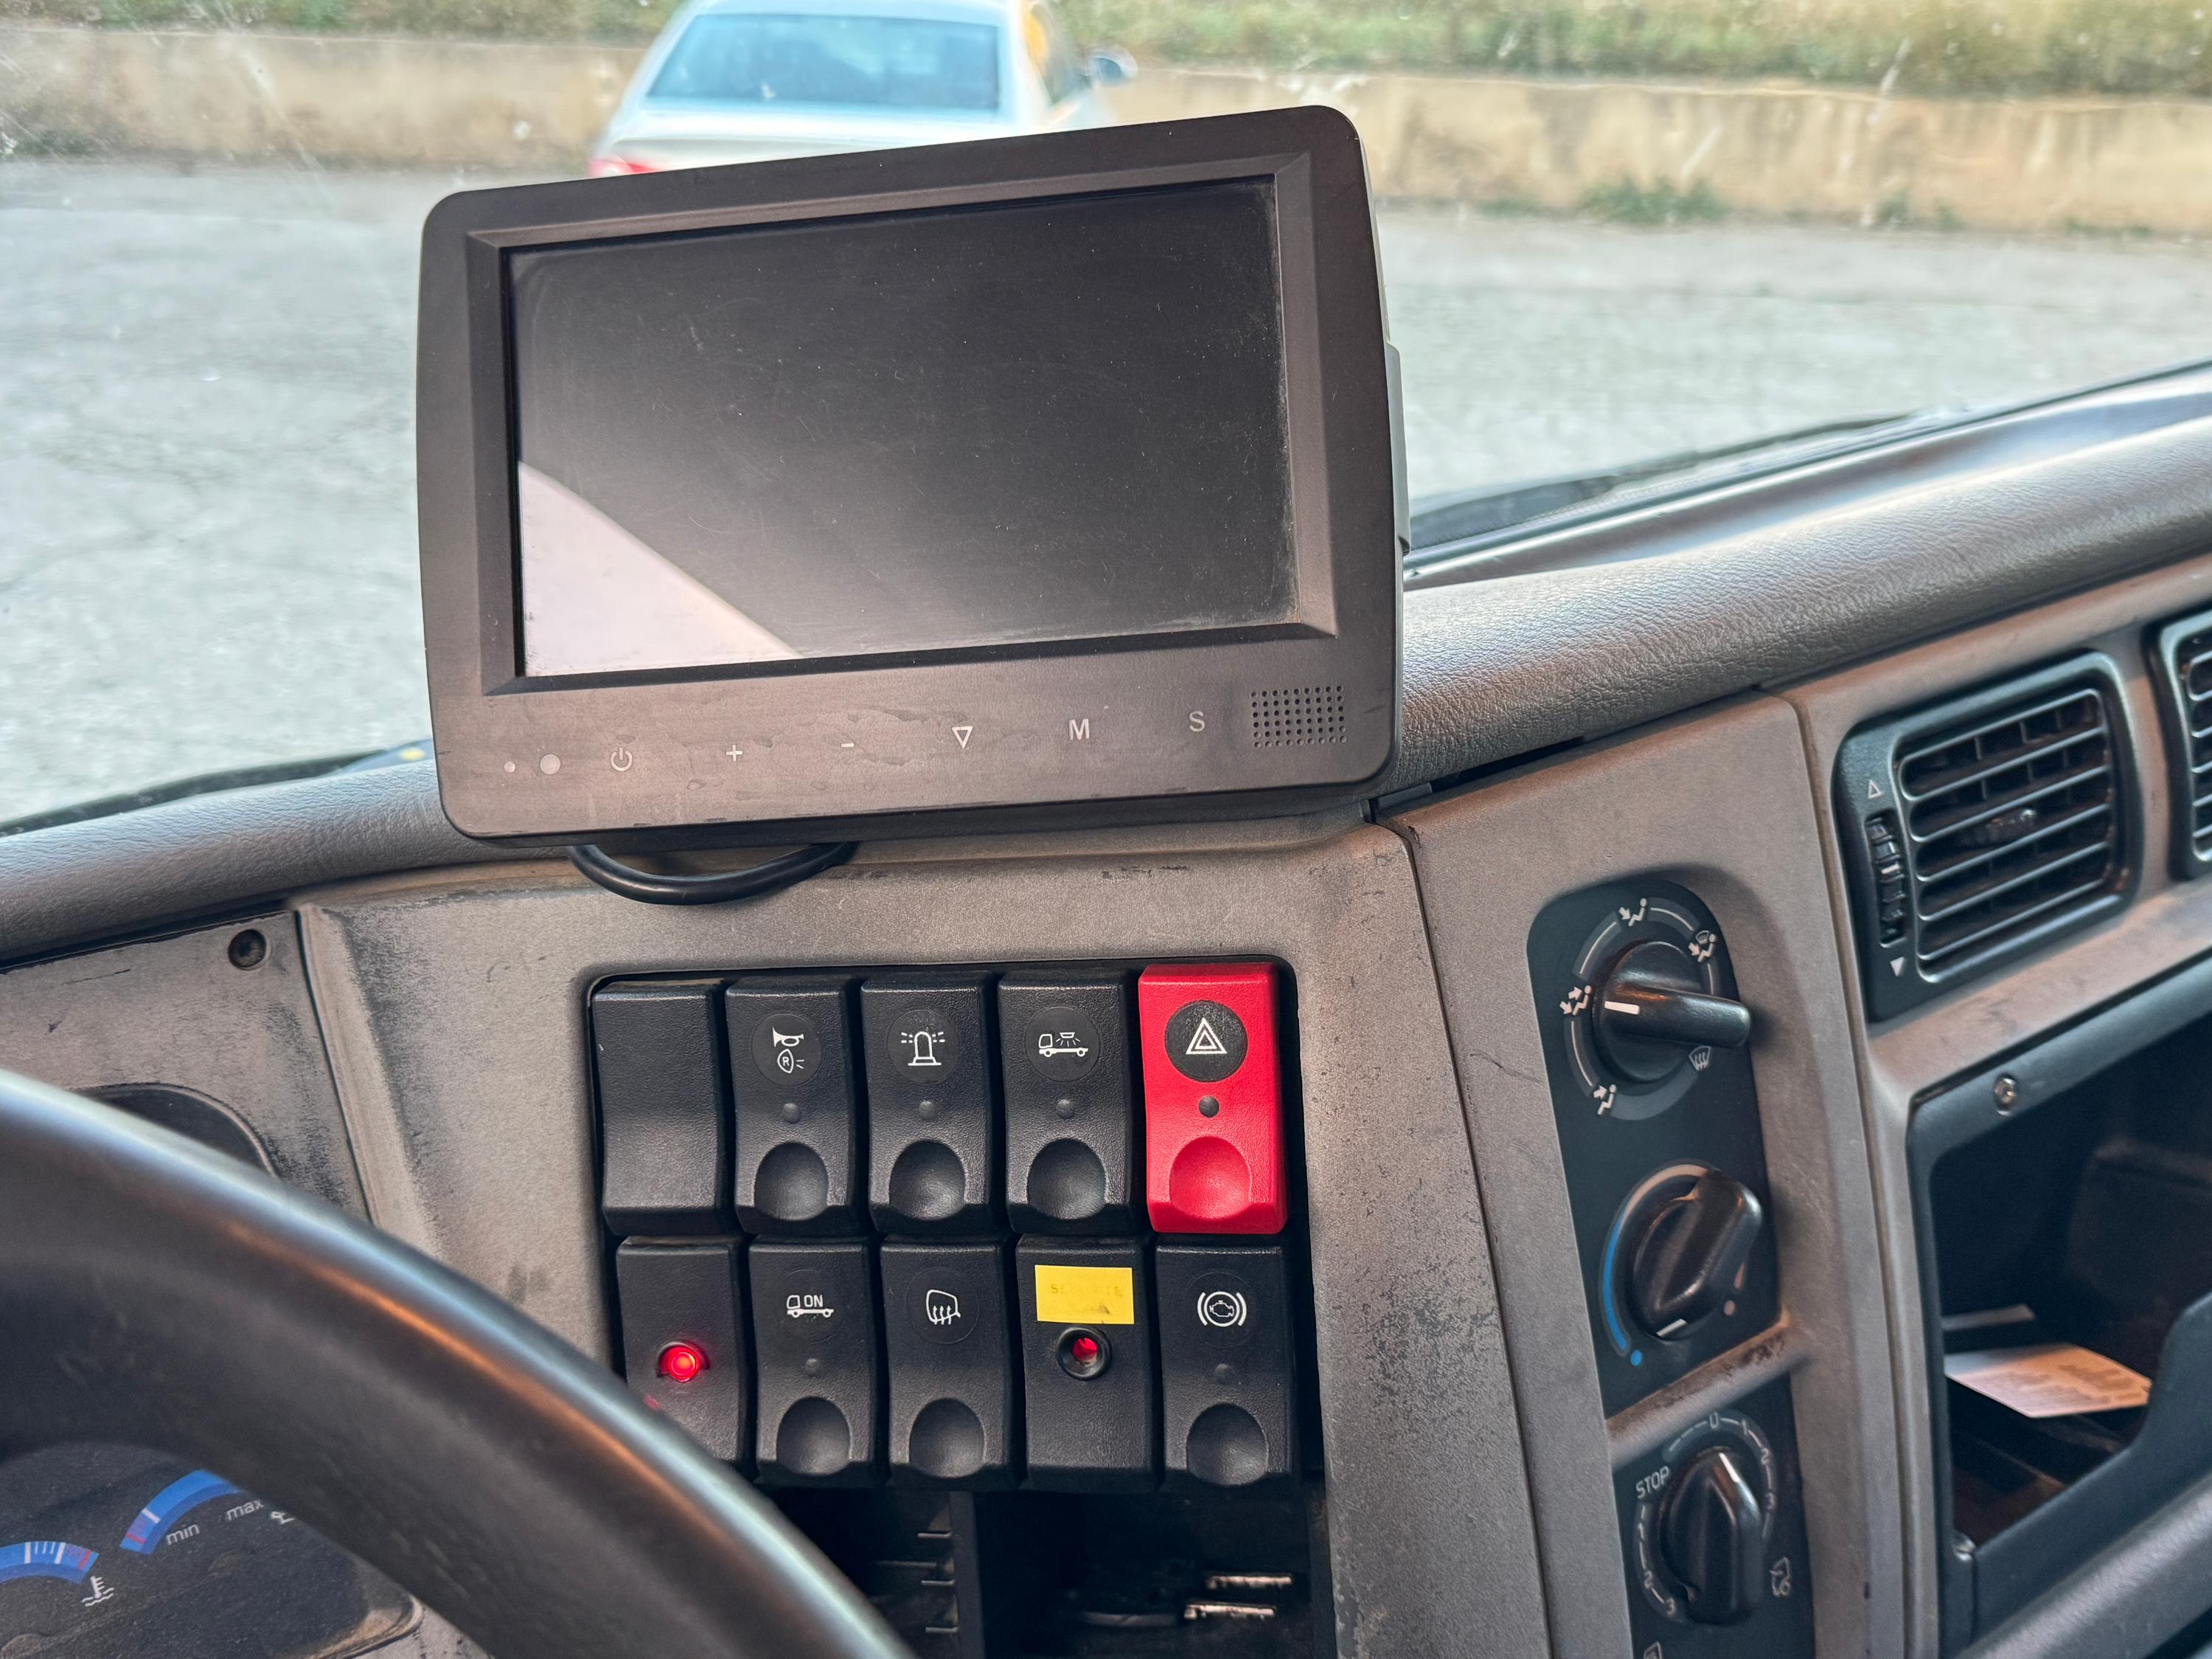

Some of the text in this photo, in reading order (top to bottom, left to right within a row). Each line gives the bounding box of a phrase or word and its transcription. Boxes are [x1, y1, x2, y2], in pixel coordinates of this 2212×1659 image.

[1068, 718, 1090, 740] M
[1189, 710, 1206, 732] S
[782, 1056, 790, 1066] R
[804, 1294, 823, 1307] ON
[1761, 1447, 1770, 1465] 2
[1635, 1465, 1671, 1499] STOP
[226, 1500, 264, 1521] max
[166, 1523, 200, 1546] min
[1644, 1570, 1653, 1589] 2
[1666, 1597, 1676, 1615] 3
